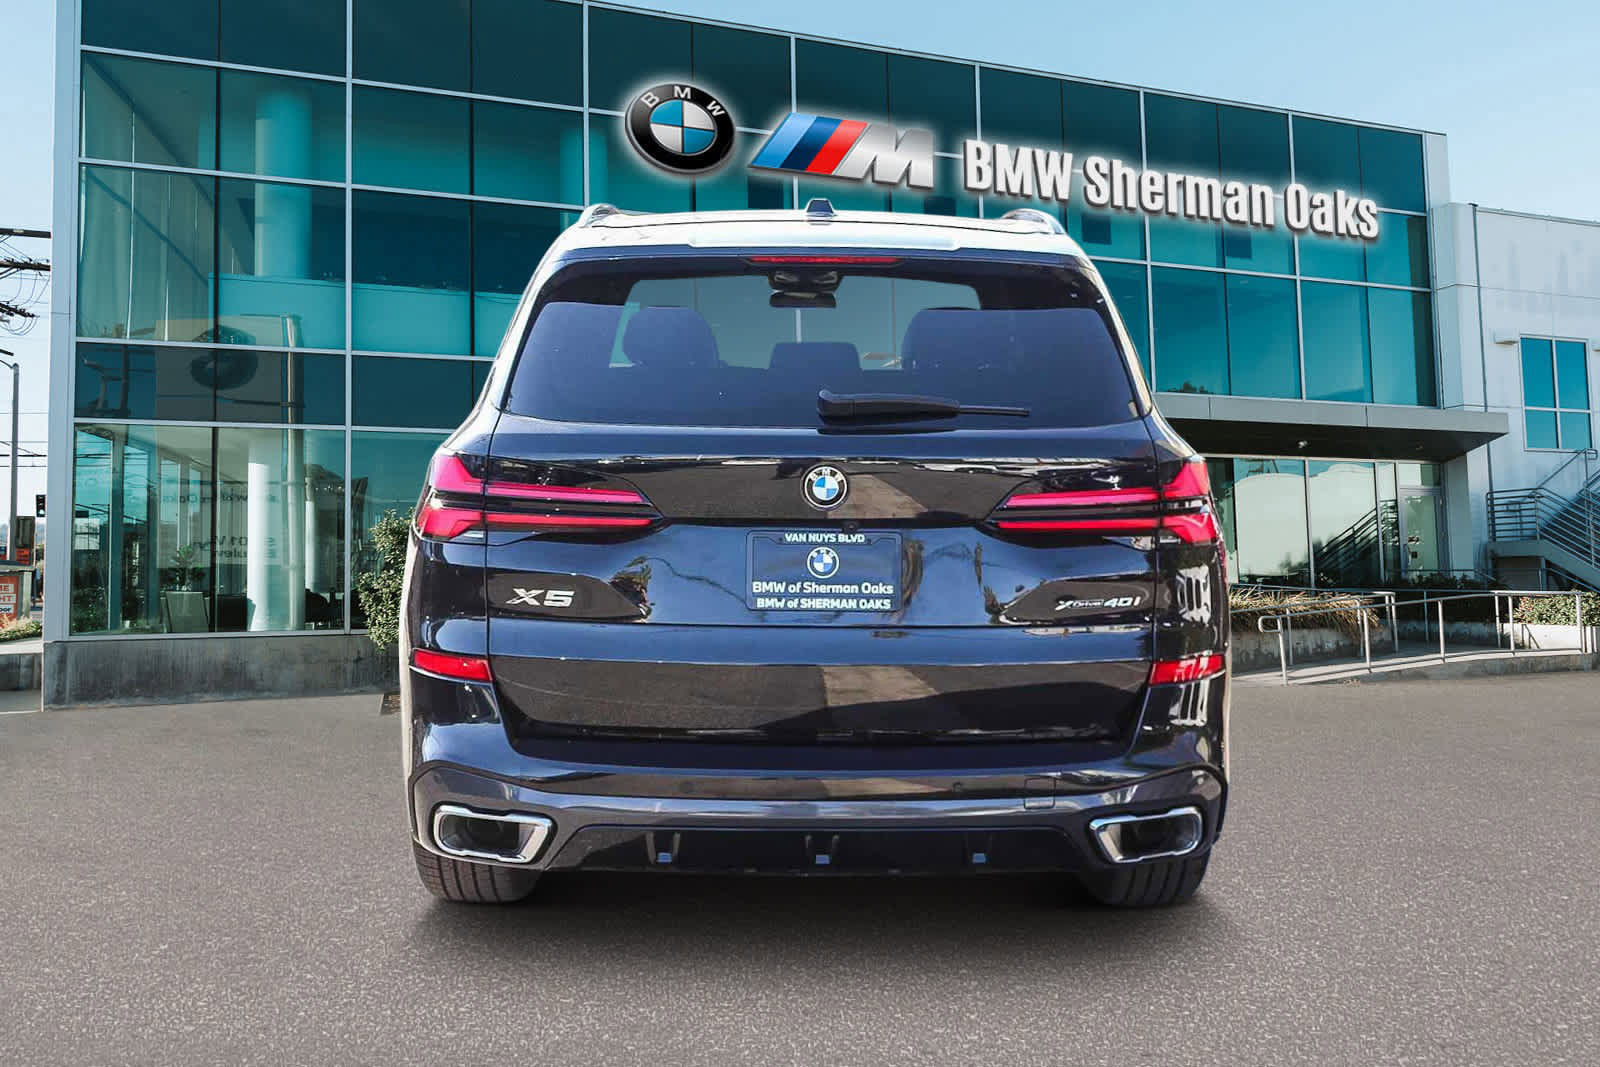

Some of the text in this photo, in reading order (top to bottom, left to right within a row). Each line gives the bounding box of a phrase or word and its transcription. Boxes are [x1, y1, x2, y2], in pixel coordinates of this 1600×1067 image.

[641, 84, 725, 117] BMW
[964, 139, 1379, 241] BMW Sherman Oaks
[785, 533, 865, 543] VAN NUYS BLVD
[752, 581, 894, 595] BMW of Sherman Oaks
[505, 588, 575, 607] X5
[757, 598, 892, 609] BMW of SHERMAN OAKS
